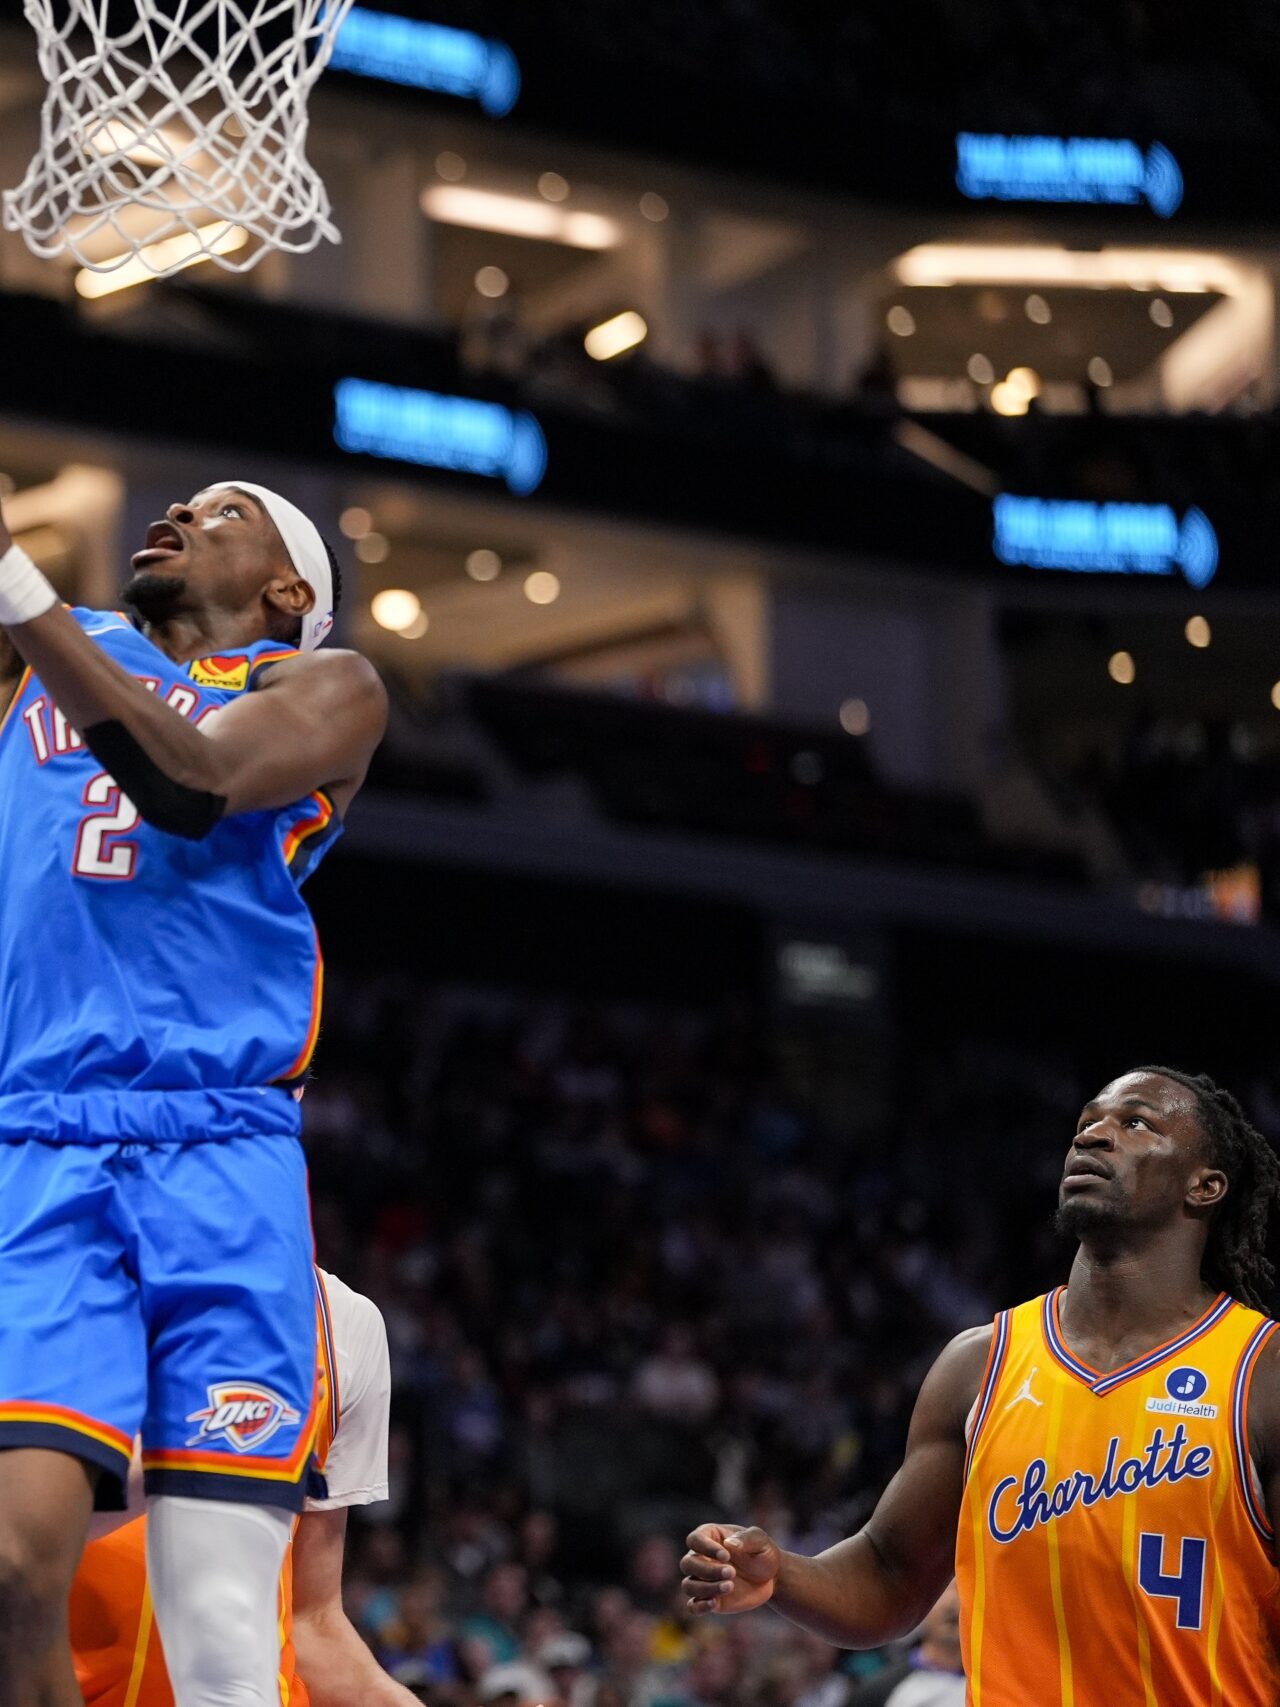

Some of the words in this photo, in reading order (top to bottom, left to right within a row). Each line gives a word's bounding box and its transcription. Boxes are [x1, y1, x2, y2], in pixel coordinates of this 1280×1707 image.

[73, 770, 142, 880] 2
[205, 1400, 273, 1432] OKC
[1147, 1400, 1176, 1412] Judi
[1177, 1403, 1216, 1418] Health
[988, 1423, 1213, 1544] Charlotte
[1138, 1532, 1207, 1631] 4
